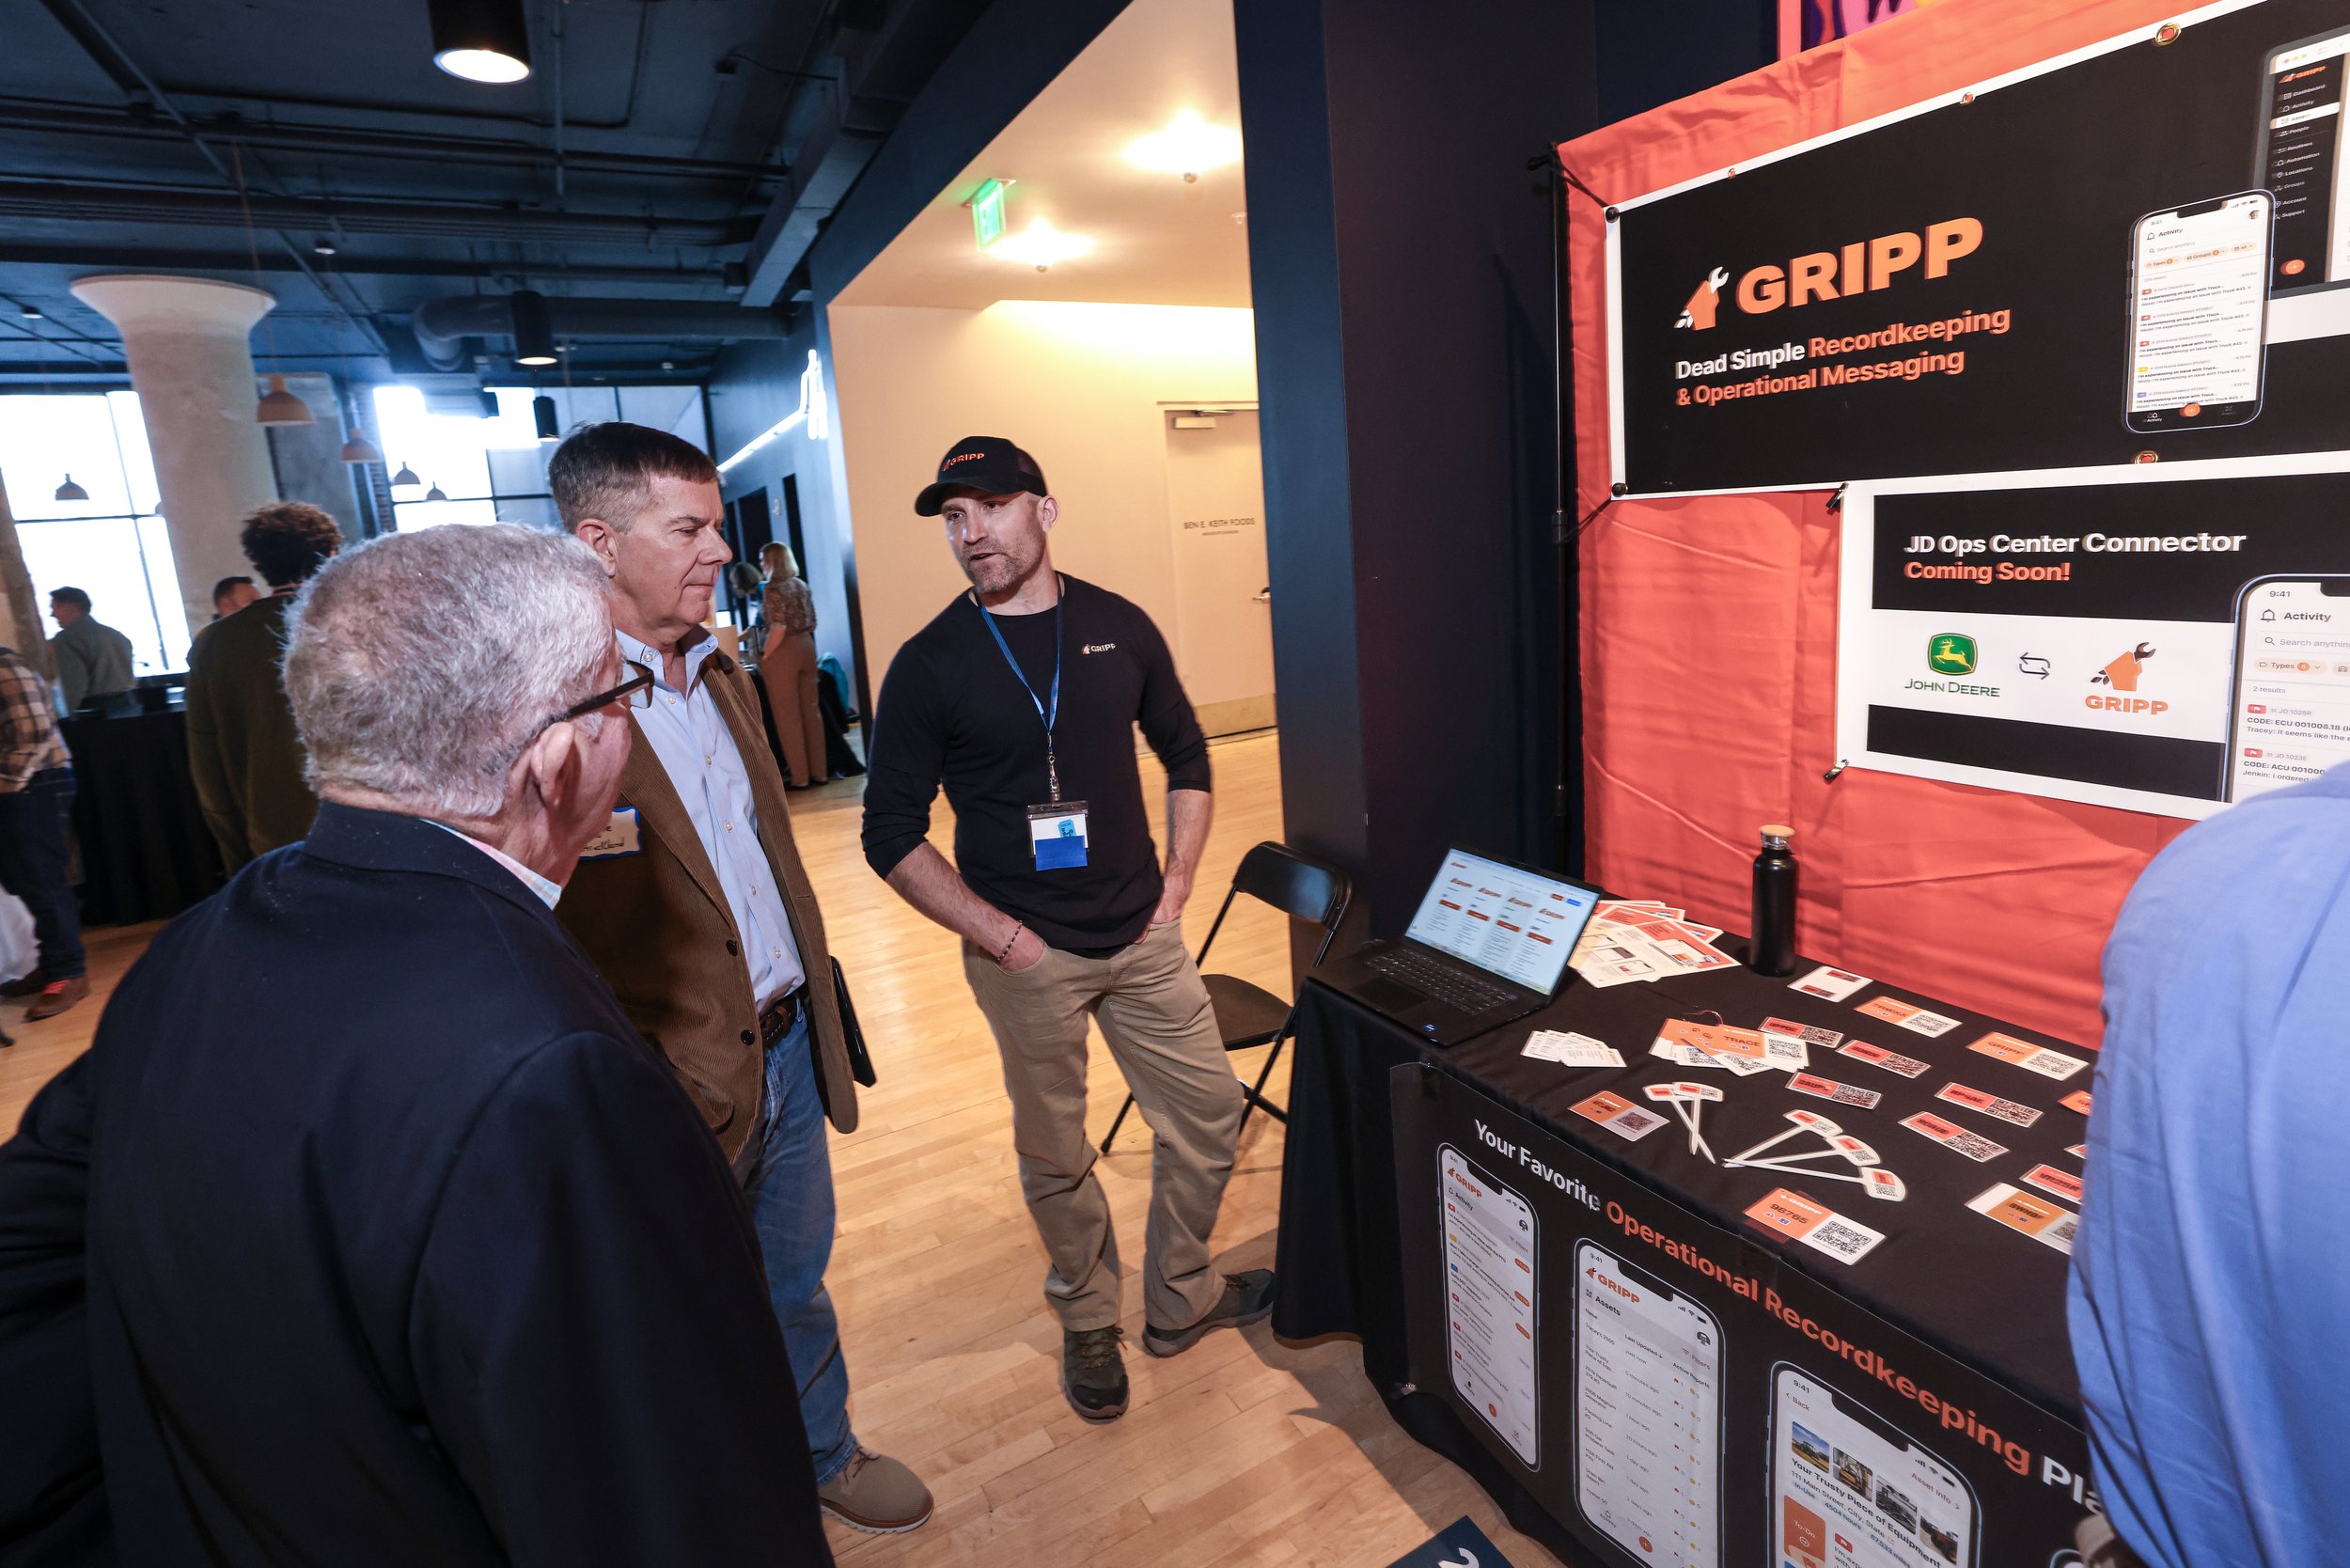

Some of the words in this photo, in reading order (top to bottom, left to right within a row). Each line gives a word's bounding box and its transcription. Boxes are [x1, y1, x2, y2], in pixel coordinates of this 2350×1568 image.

[2293, 83, 2326, 97] Dashboard
[2292, 99, 2314, 110] Activity
[2289, 124, 2310, 134] People
[2287, 140, 2312, 151] Routines
[2286, 150, 2320, 165] Automation
[2284, 165, 2313, 177] Locations
[2283, 179, 2305, 189] Groups
[2282, 196, 2307, 206] Account
[2281, 208, 2305, 219] Support
[2158, 226, 2183, 238] Activity
[2192, 251, 2211, 259] Groups
[1736, 217, 1983, 314] GRIPP
[2148, 291, 2176, 301] experiencing
[1675, 354, 1727, 379] Dead
[1730, 342, 1806, 371] Simple
[1809, 309, 2011, 359] Recordkeeping
[1676, 387, 1691, 406] &
[1693, 369, 1817, 407] Operational
[1820, 351, 1966, 386] Messaging
[950, 453, 985, 465] GRIPP
[1209, 519, 1229, 527] KEITH
[1230, 518, 1255, 526] FOODS
[1904, 536, 1935, 553] JD
[1938, 535, 1986, 557] Ops
[1990, 534, 2079, 553] Center
[2082, 532, 2248, 552] Connector
[1904, 561, 1993, 584] Coming
[1996, 562, 2071, 581] Soon!
[2283, 612, 2331, 622] Activity
[1090, 643, 1116, 652] GRIPP
[2280, 638, 2311, 647] Search
[1904, 679, 1945, 692] JOHN
[1948, 682, 2000, 697] DEERE
[2085, 695, 2169, 715] GRIPP
[2247, 727, 2276, 735] Tracey:
[2295, 722, 2341, 730] 001008.18
[2243, 770, 2271, 778] Jenkin:
[1723, 1036, 1762, 1047] TRACE
[1455, 1171, 1481, 1200] GRIPP
[1454, 1190, 1473, 1212] Activity
[1769, 1203, 1810, 1224] 98765
[1590, 1251, 1603, 1265] 9:41
[1597, 1272, 1640, 1308] GRIPP
[1475, 1119, 1516, 1158] Your
[1519, 1147, 1602, 1212] Favorite
[1606, 1200, 1758, 1302] Operational
[1765, 1286, 2030, 1477] Recordkeeping
[1595, 1294, 1621, 1318] Assets
[1624, 1333, 1636, 1345] Last
[1636, 1340, 1658, 1358] Updated
[1691, 1354, 1711, 1372] Filters
[1672, 1361, 1690, 1377] Active
[1689, 1371, 1710, 1390] Reports
[1651, 1386, 1659, 1396] ago
[1794, 1379, 1810, 1394] 9:41
[1793, 1396, 1810, 1411] Back
[1652, 1407, 1662, 1419] ago
[1794, 1482, 1815, 1498] In-Use
[1911, 1472, 1934, 1491] Asset
[1935, 1488, 1951, 1504] Info
[1792, 1471, 1802, 1481] 111
[1803, 1478, 1821, 1494] Main
[1822, 1489, 1846, 1510] Street,
[1866, 1519, 1886, 1538] State
[1792, 1458, 1813, 1476] Your
[1814, 1472, 1845, 1497] Trusty
[1847, 1494, 1878, 1517] Piece
[1875, 1514, 1887, 1528] of
[1888, 1523, 1941, 1568] Equipment
[1825, 1502, 1841, 1518] 4504
[1842, 1513, 1861, 1530] hours
[1835, 1546, 1845, 1558] I'm
[1893, 1547, 1911, 1568] miles
